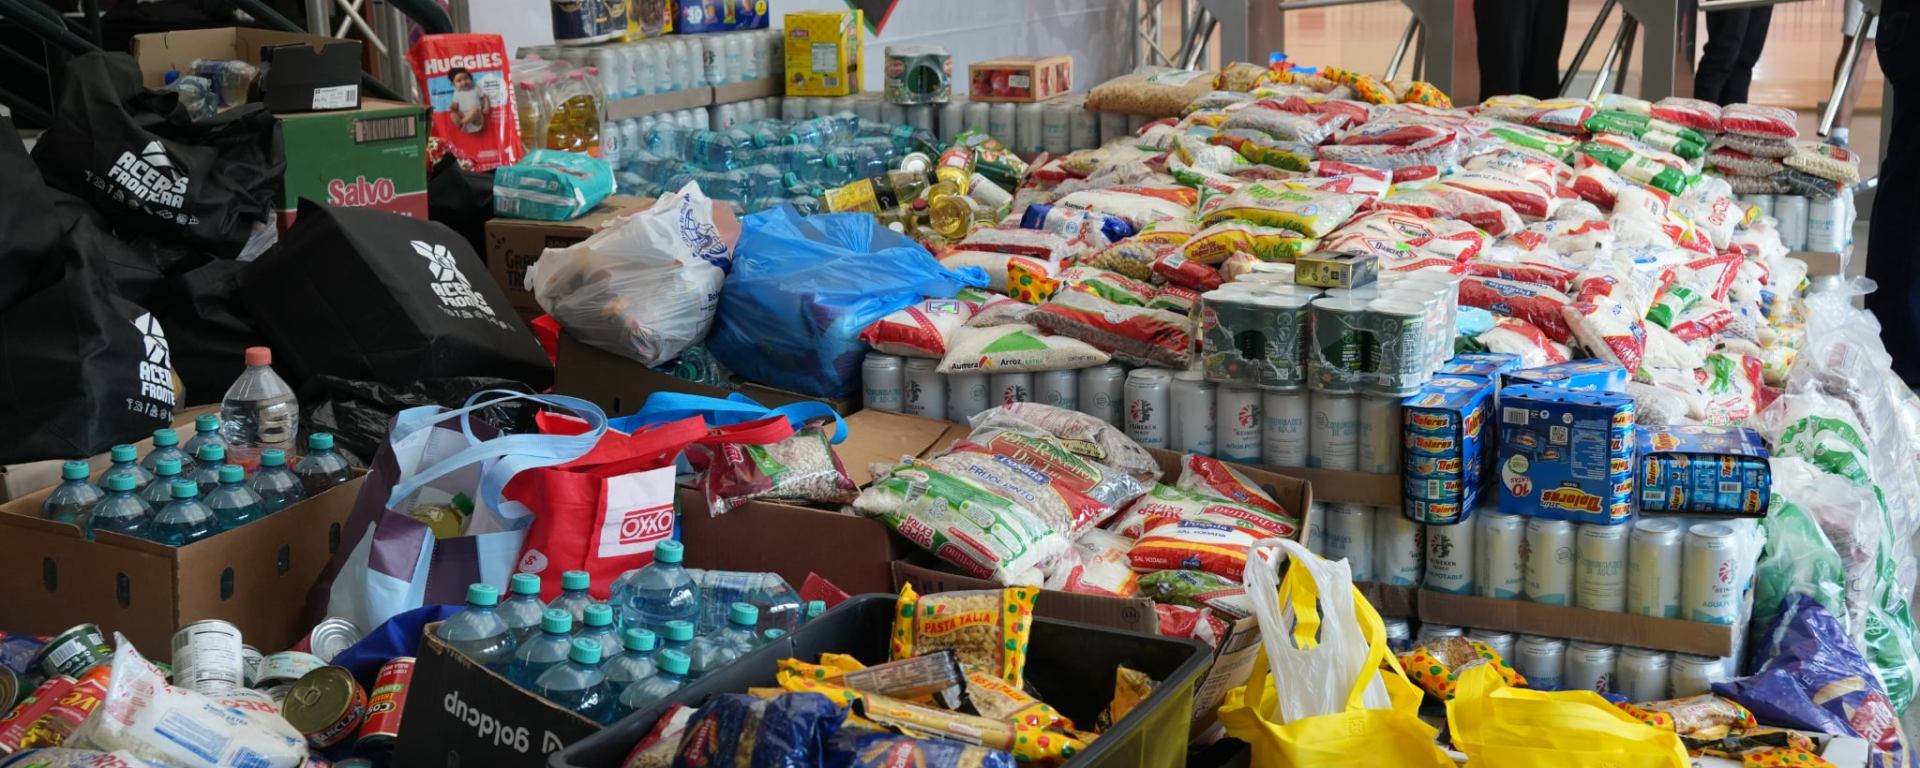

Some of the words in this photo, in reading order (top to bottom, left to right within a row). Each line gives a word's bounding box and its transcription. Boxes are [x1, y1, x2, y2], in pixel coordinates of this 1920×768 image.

[424, 52, 503, 75] HUGGIES
[328, 176, 394, 207] Salvo
[951, 361, 979, 370] Aurrera
[1000, 358, 1021, 367] Arroz
[968, 464, 1001, 485] FRIJOL
[1000, 456, 1045, 482] Posada
[622, 510, 674, 539] OXXO
[898, 521, 932, 548] SUPER
[907, 515, 933, 538] EXTRA
[924, 619, 956, 634] PASTA
[444, 690, 530, 753] goldcup
